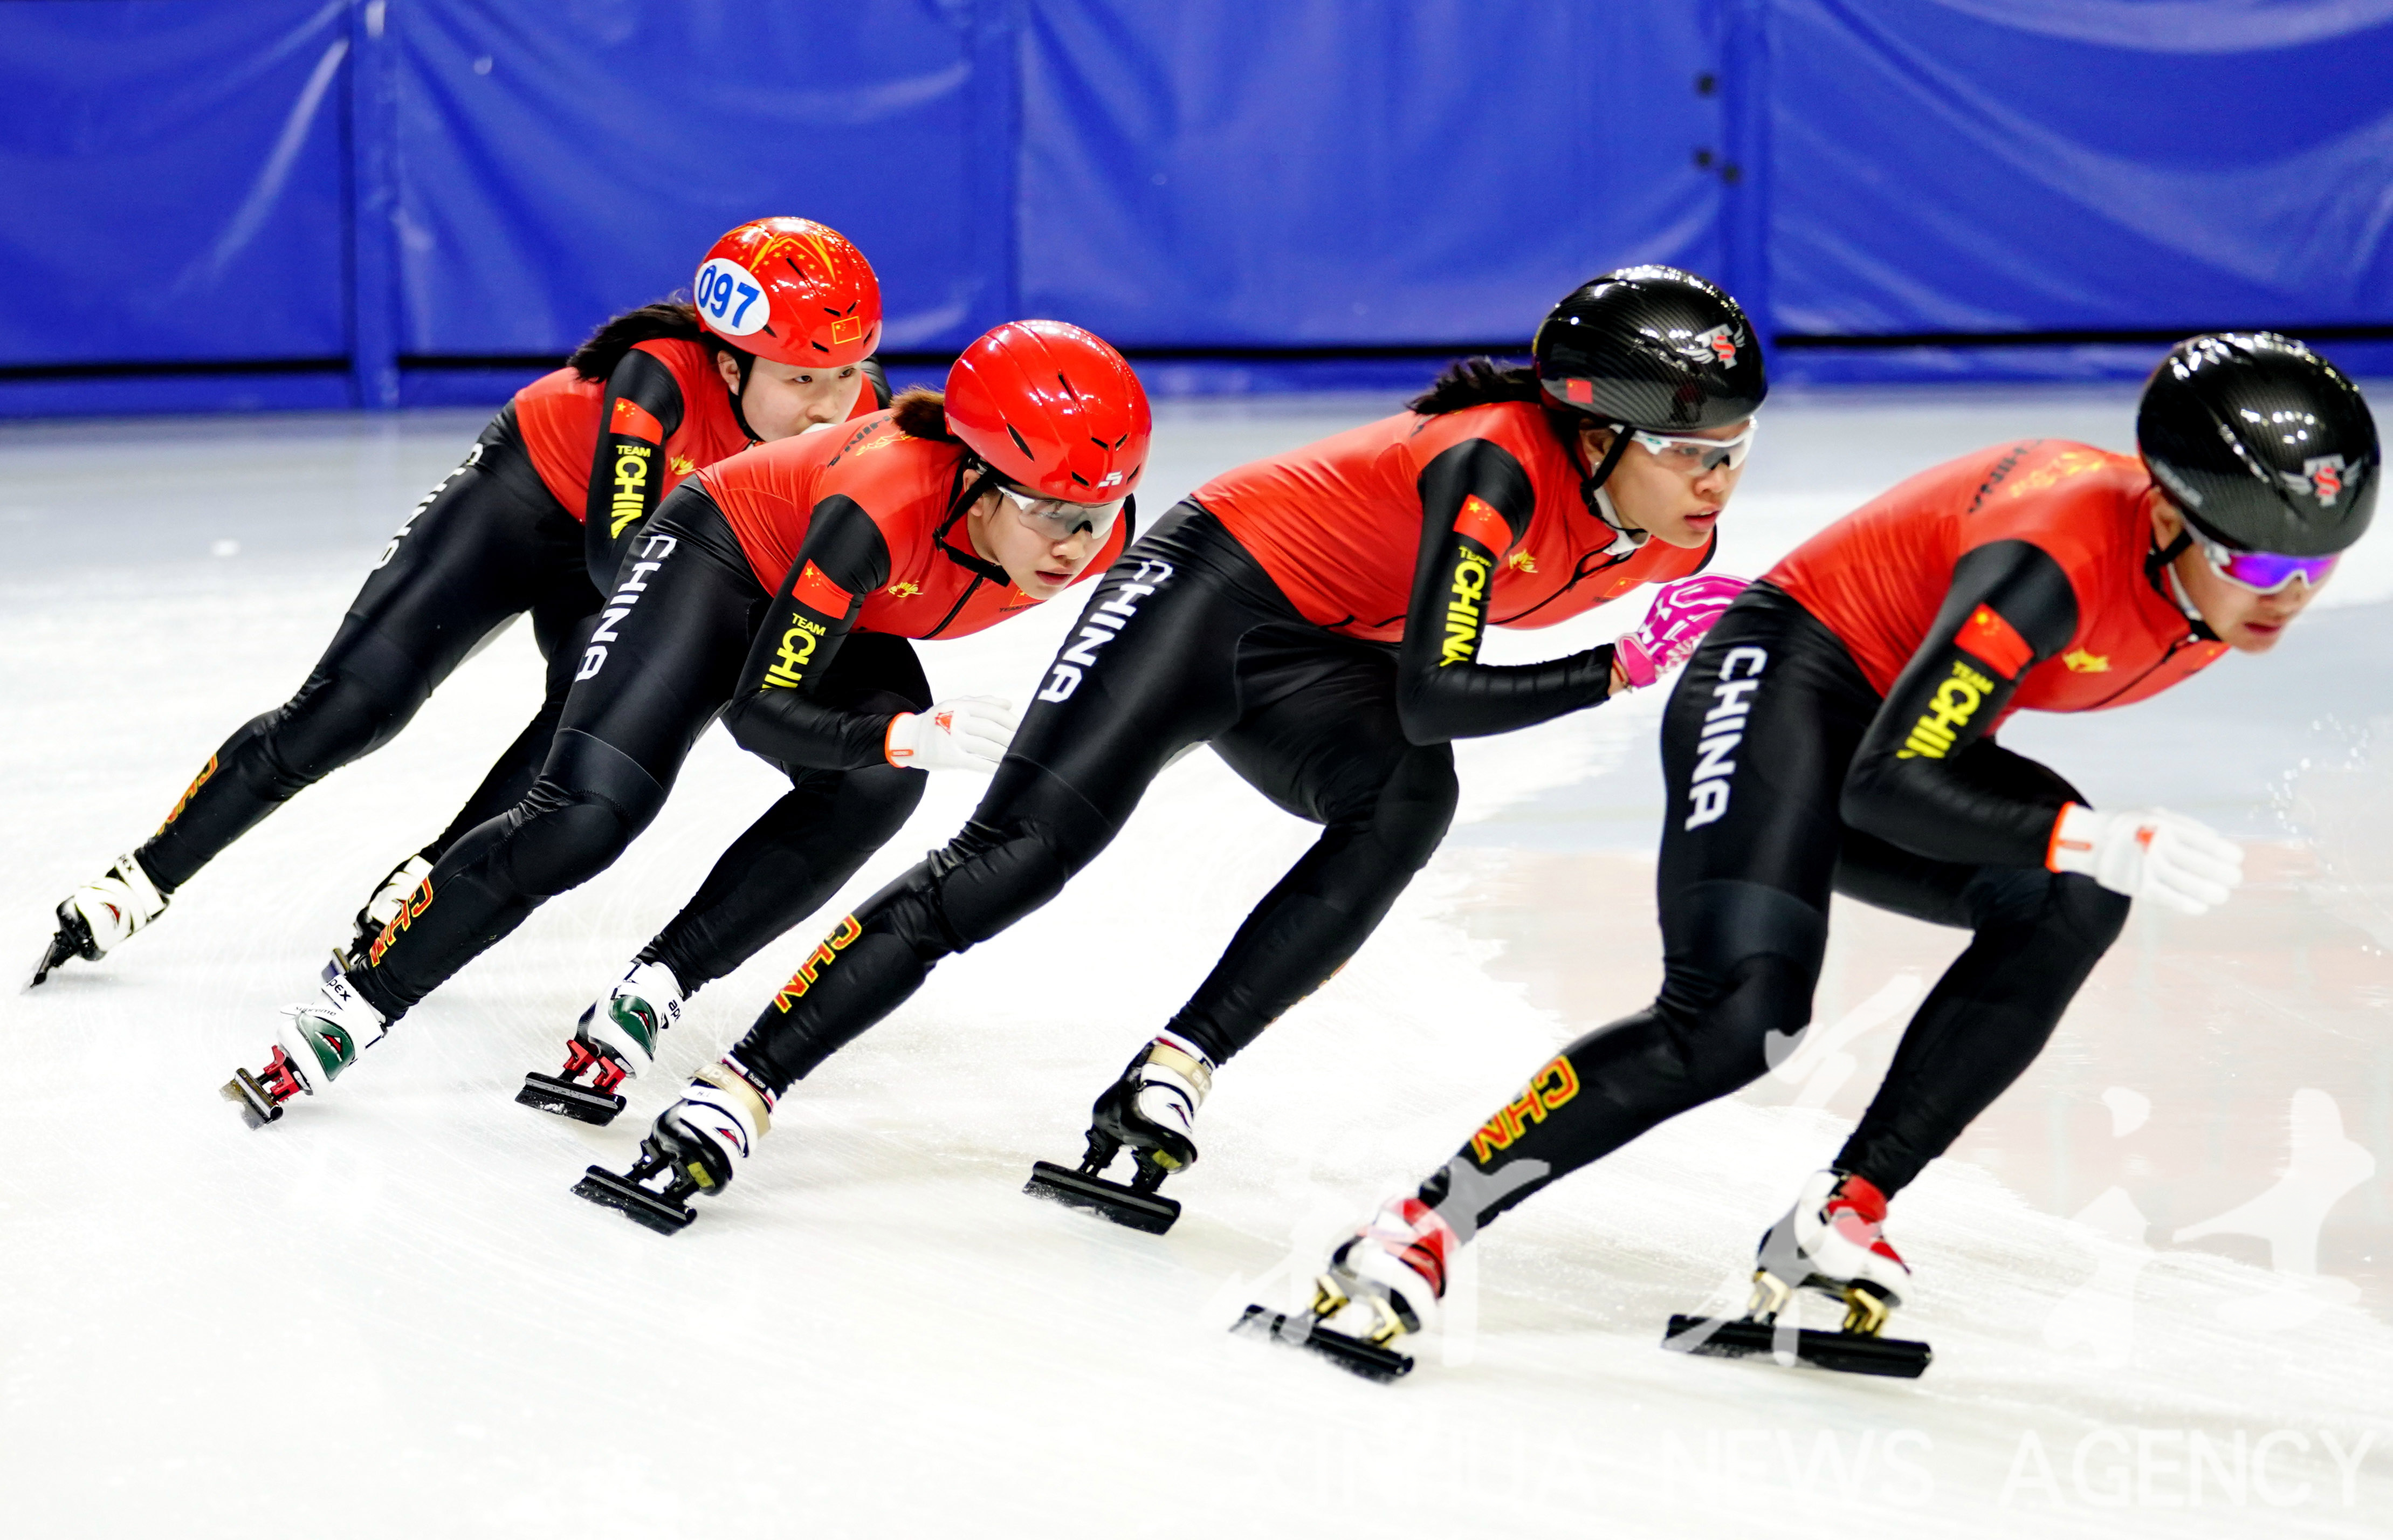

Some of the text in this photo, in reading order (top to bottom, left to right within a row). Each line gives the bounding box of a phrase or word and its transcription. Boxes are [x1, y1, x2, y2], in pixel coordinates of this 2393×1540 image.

[698, 265, 760, 328] 097
[616, 445, 651, 457] TEAM
[574, 534, 677, 683] CHINA
[792, 612, 827, 637] TEAM
[1037, 560, 1174, 703] CHINA
[1684, 646, 1769, 831] CHINA
[773, 913, 863, 1014] CHN
[1469, 1054, 1580, 1164] CHN
